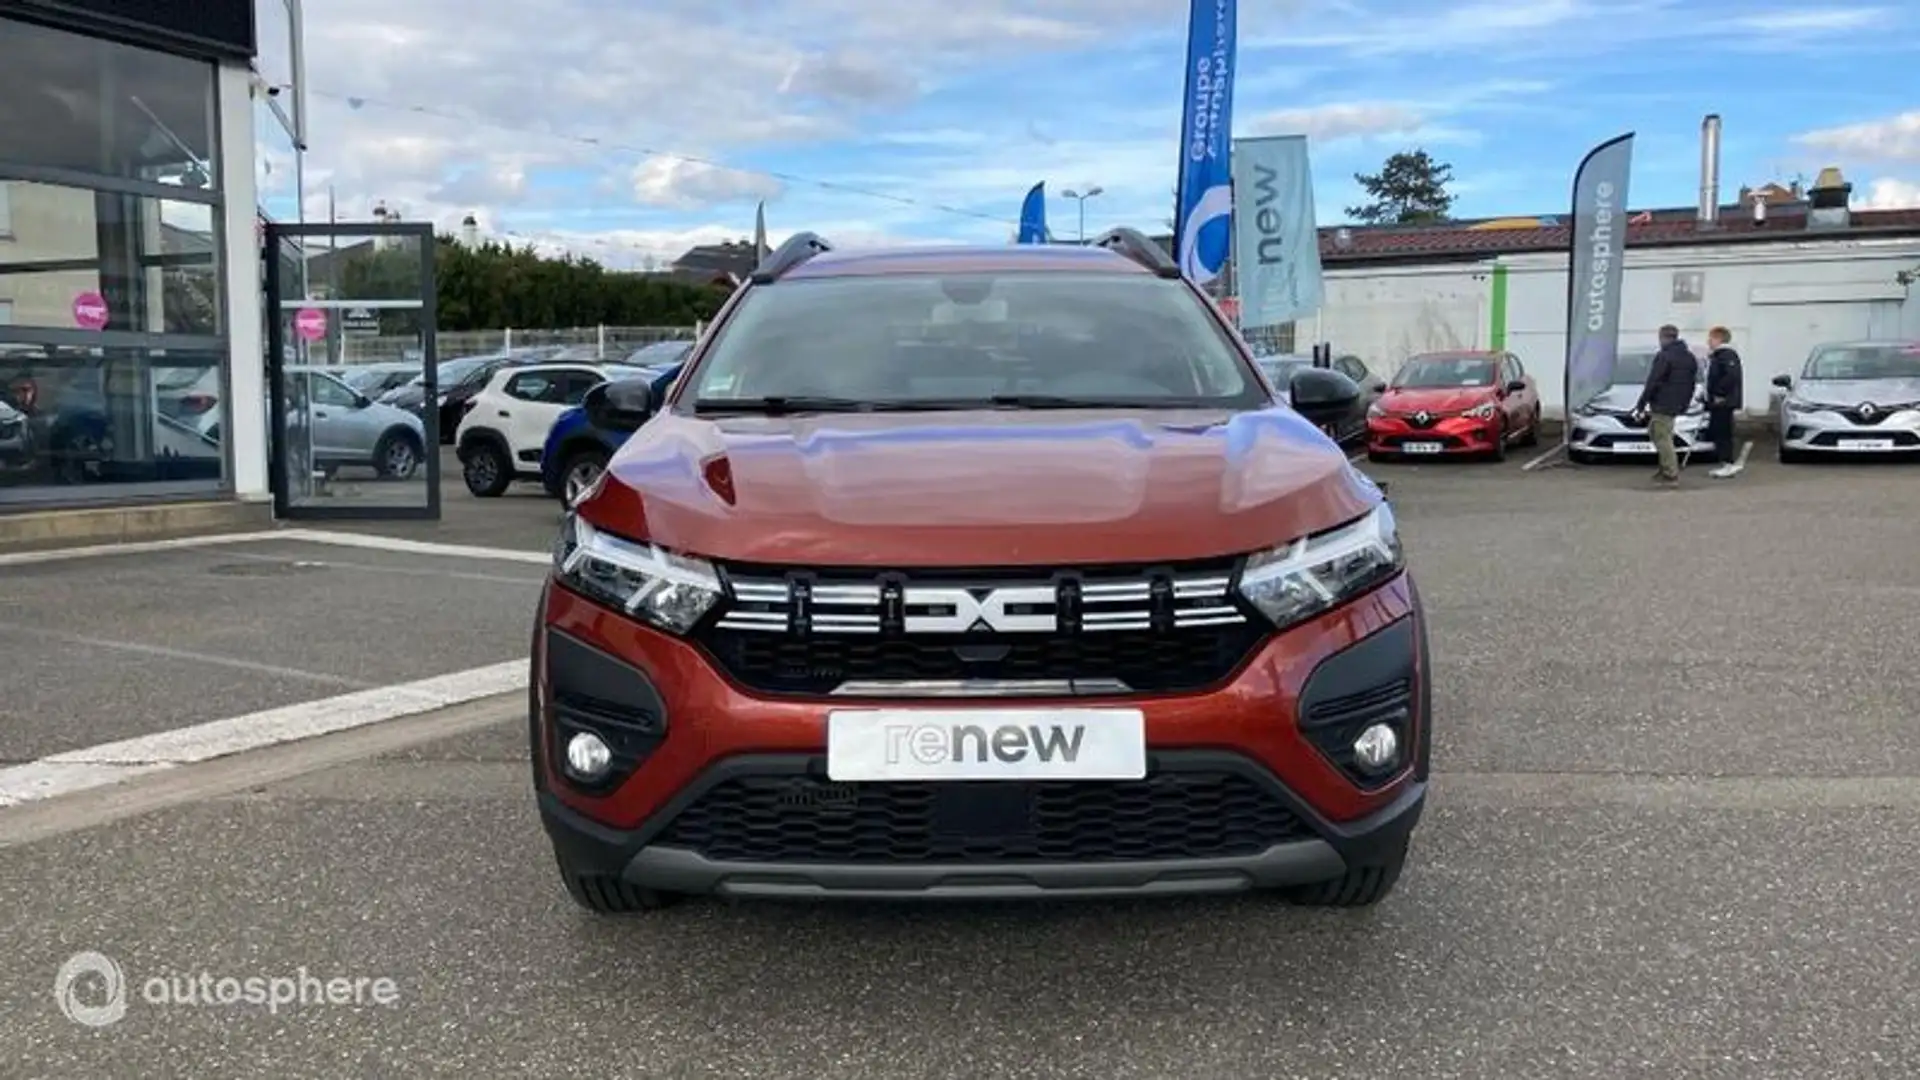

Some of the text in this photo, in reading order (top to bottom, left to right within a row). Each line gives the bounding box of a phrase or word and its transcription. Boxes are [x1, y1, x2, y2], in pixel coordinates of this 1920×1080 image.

[1190, 57, 1211, 161] Groupe
[1588, 181, 1615, 331] autosphere
[883, 723, 1085, 764] renew
